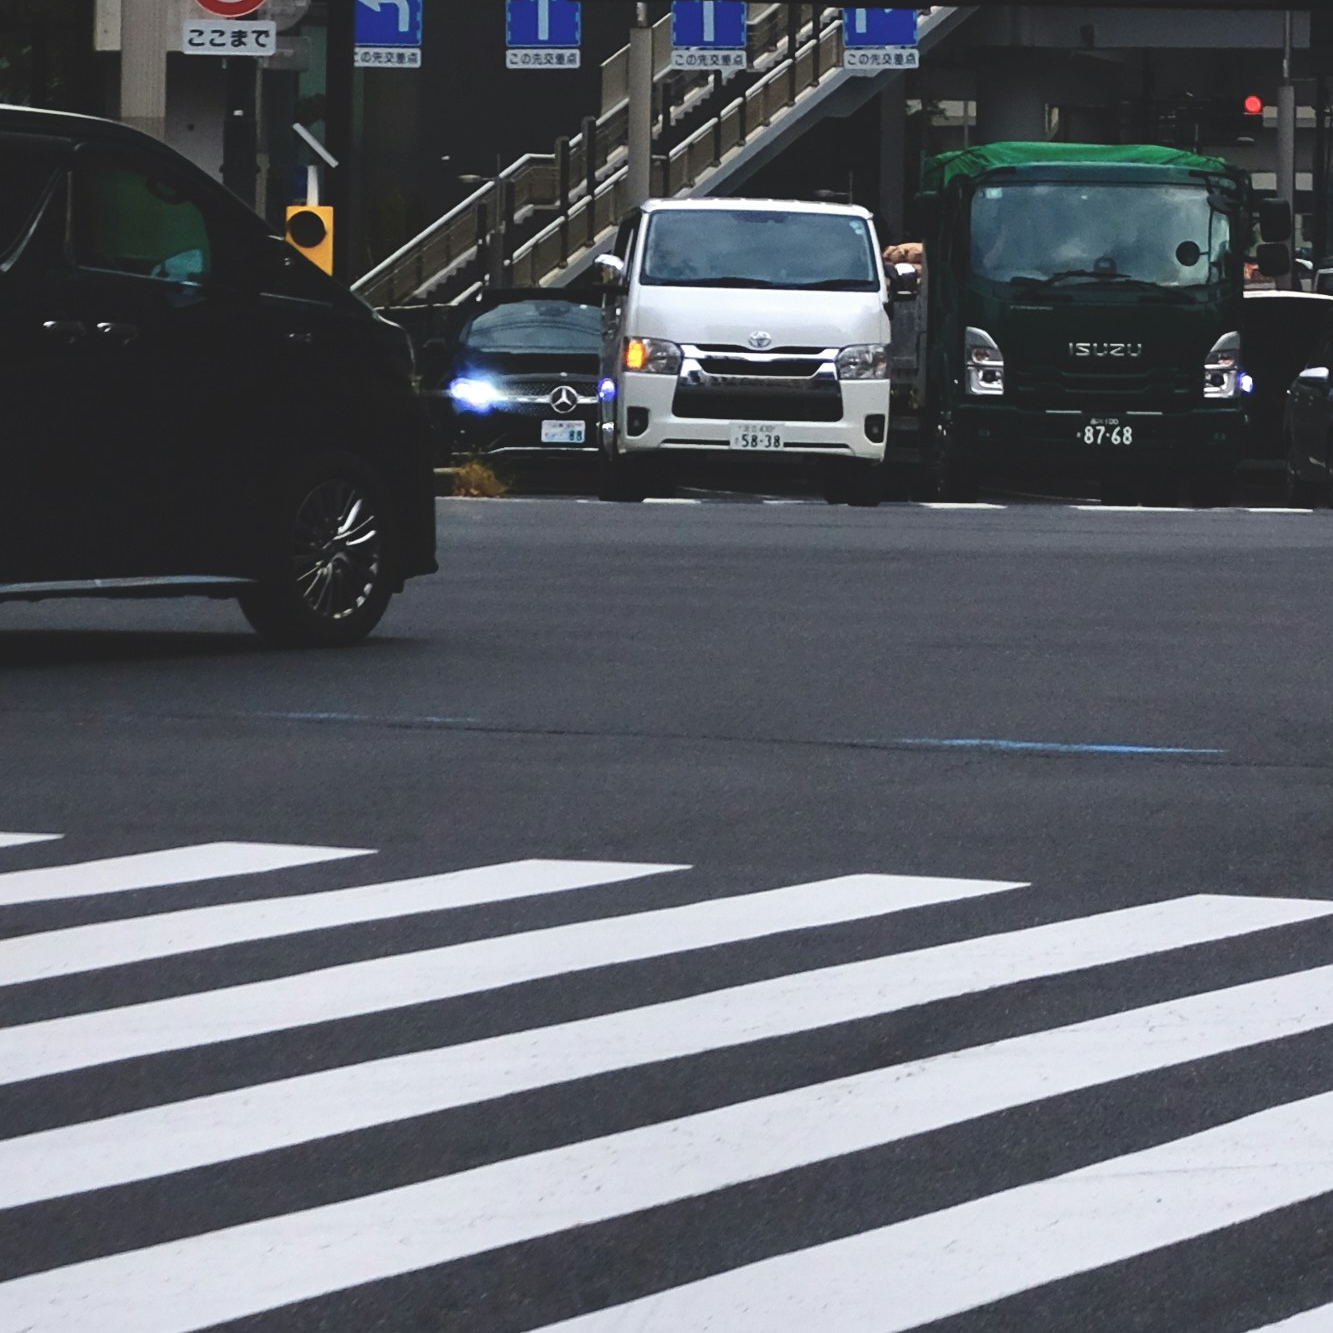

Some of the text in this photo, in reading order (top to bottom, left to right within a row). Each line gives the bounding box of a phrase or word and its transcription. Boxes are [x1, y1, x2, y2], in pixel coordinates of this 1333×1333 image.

[188, 29, 270, 48] ここまで
[1069, 342, 1142, 356] ISUZU
